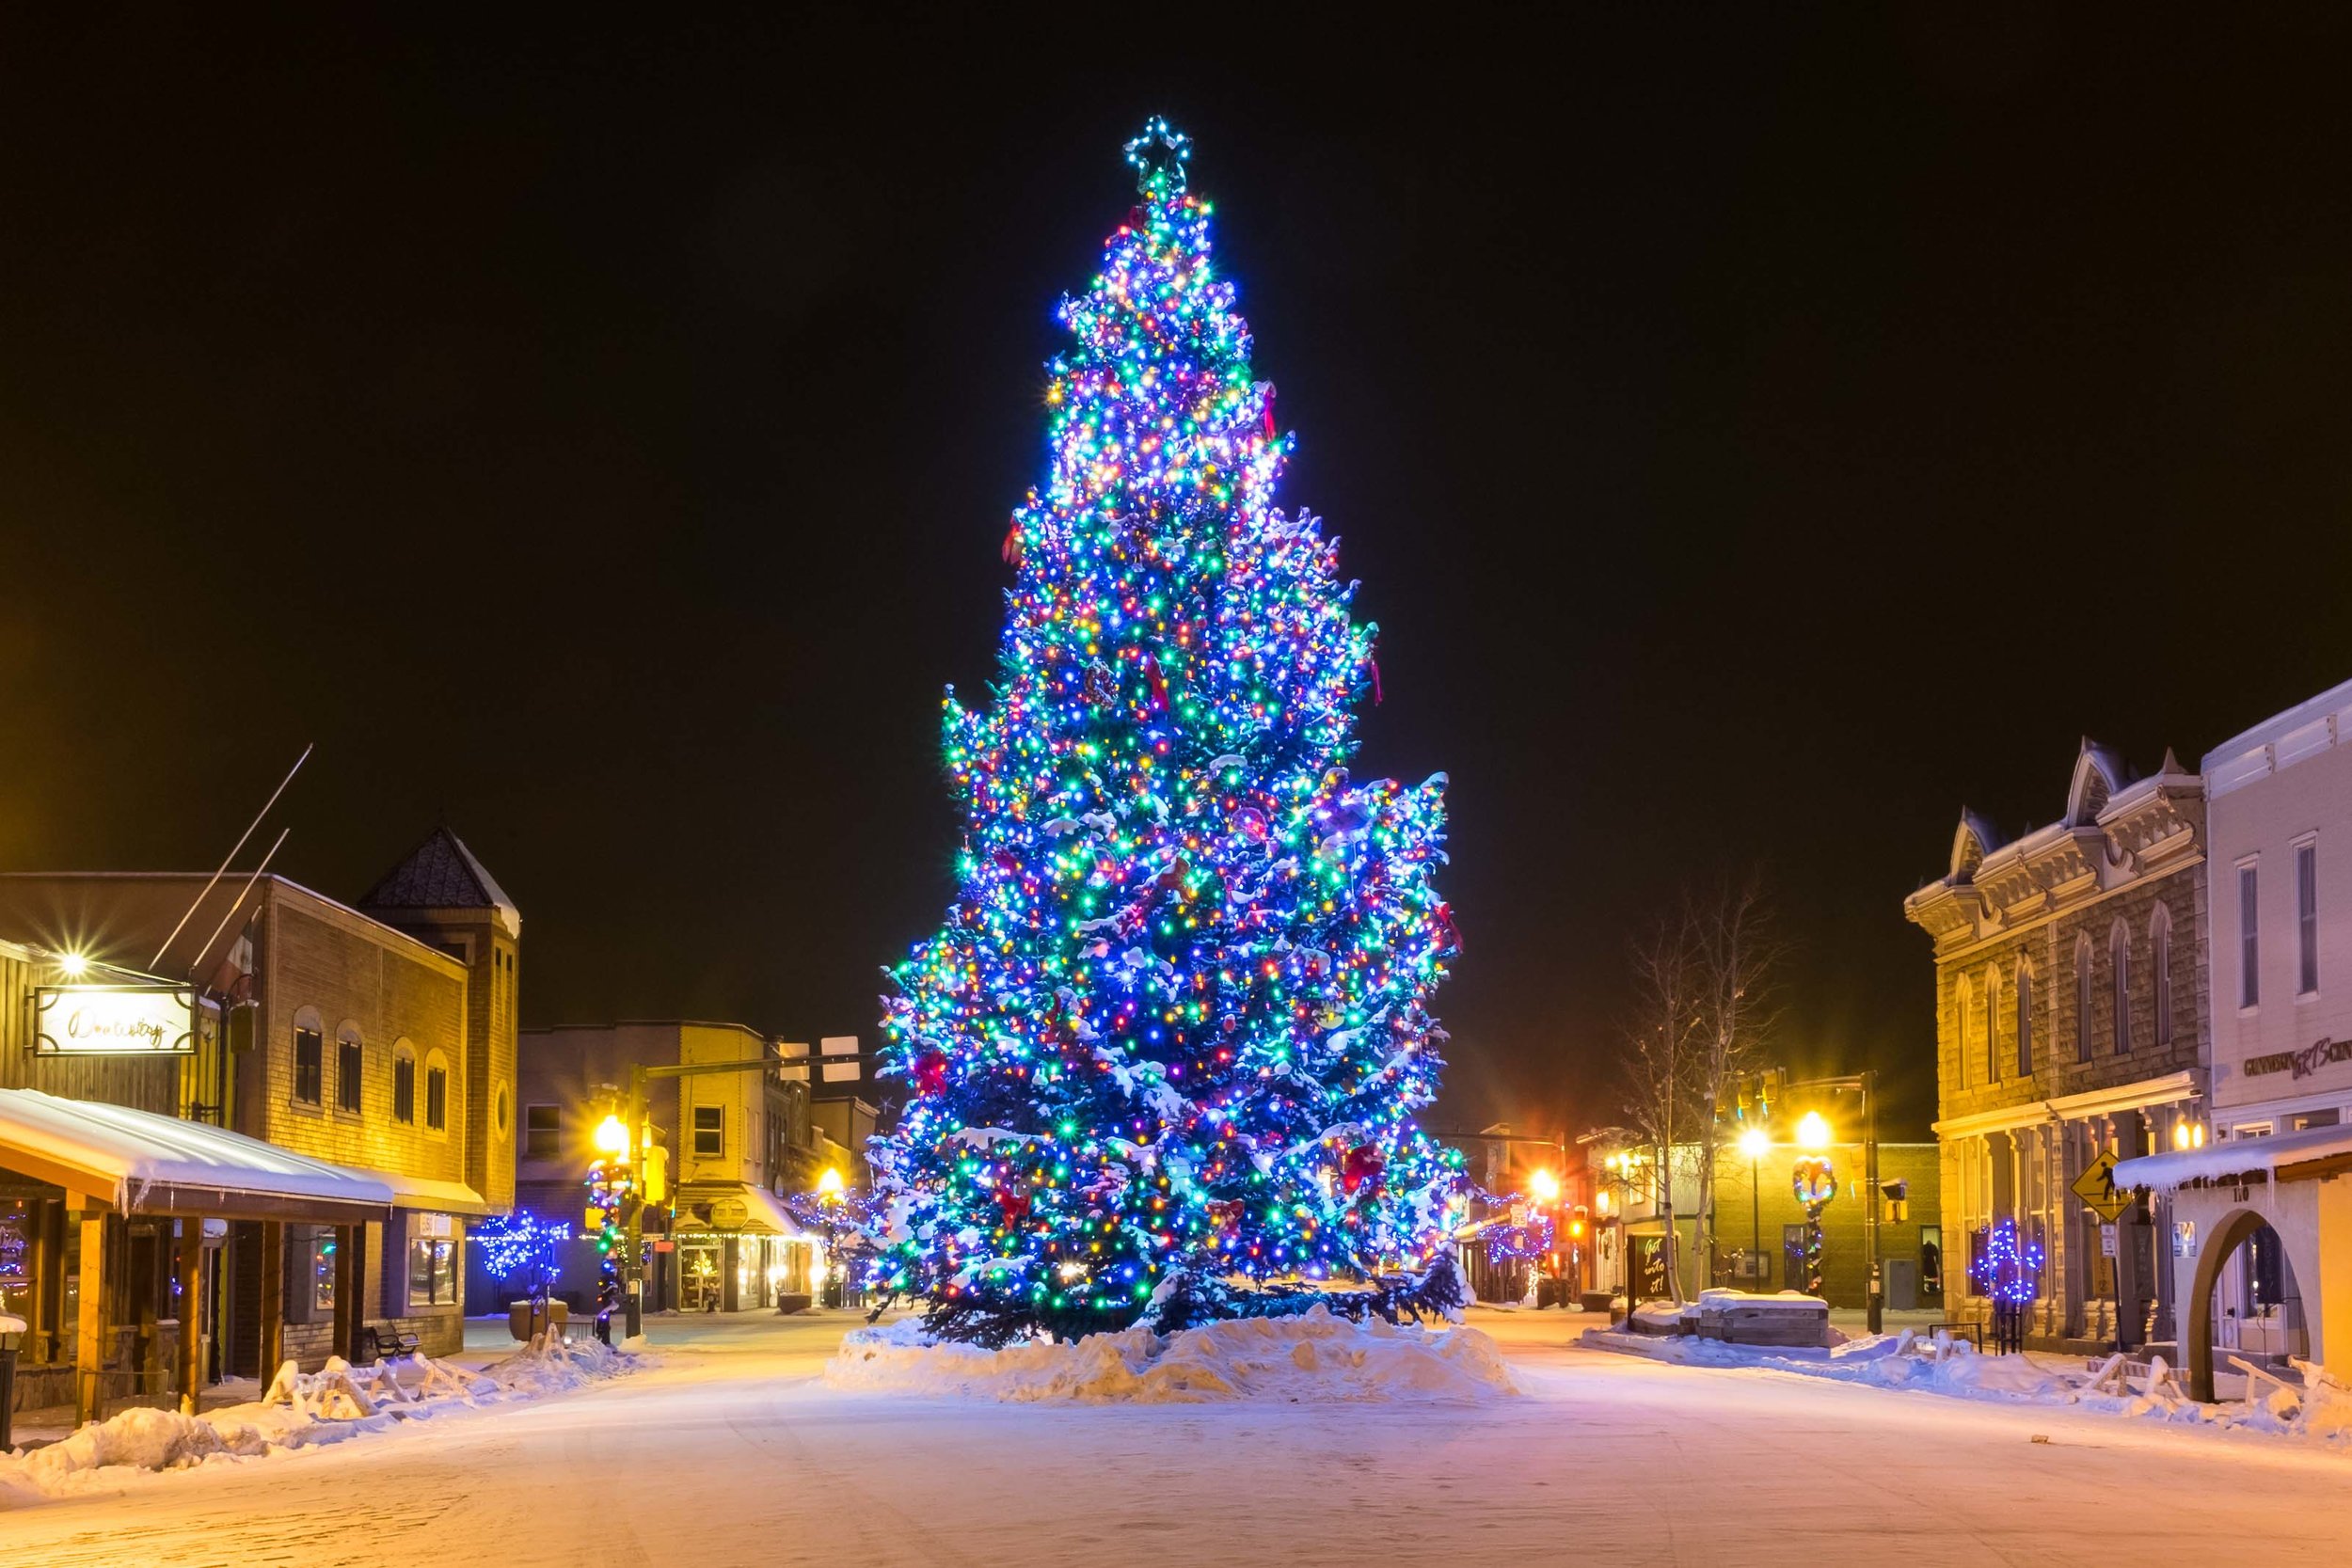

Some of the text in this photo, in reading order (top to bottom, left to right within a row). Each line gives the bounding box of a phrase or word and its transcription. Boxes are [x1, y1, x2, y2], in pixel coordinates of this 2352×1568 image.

[2233, 1186, 2249, 1203] 110
[1514, 1216, 1526, 1226] 25
[1645, 1238, 1662, 1266] Get
[1644, 1258, 1665, 1275] into
[1649, 1275, 1663, 1293] it!
